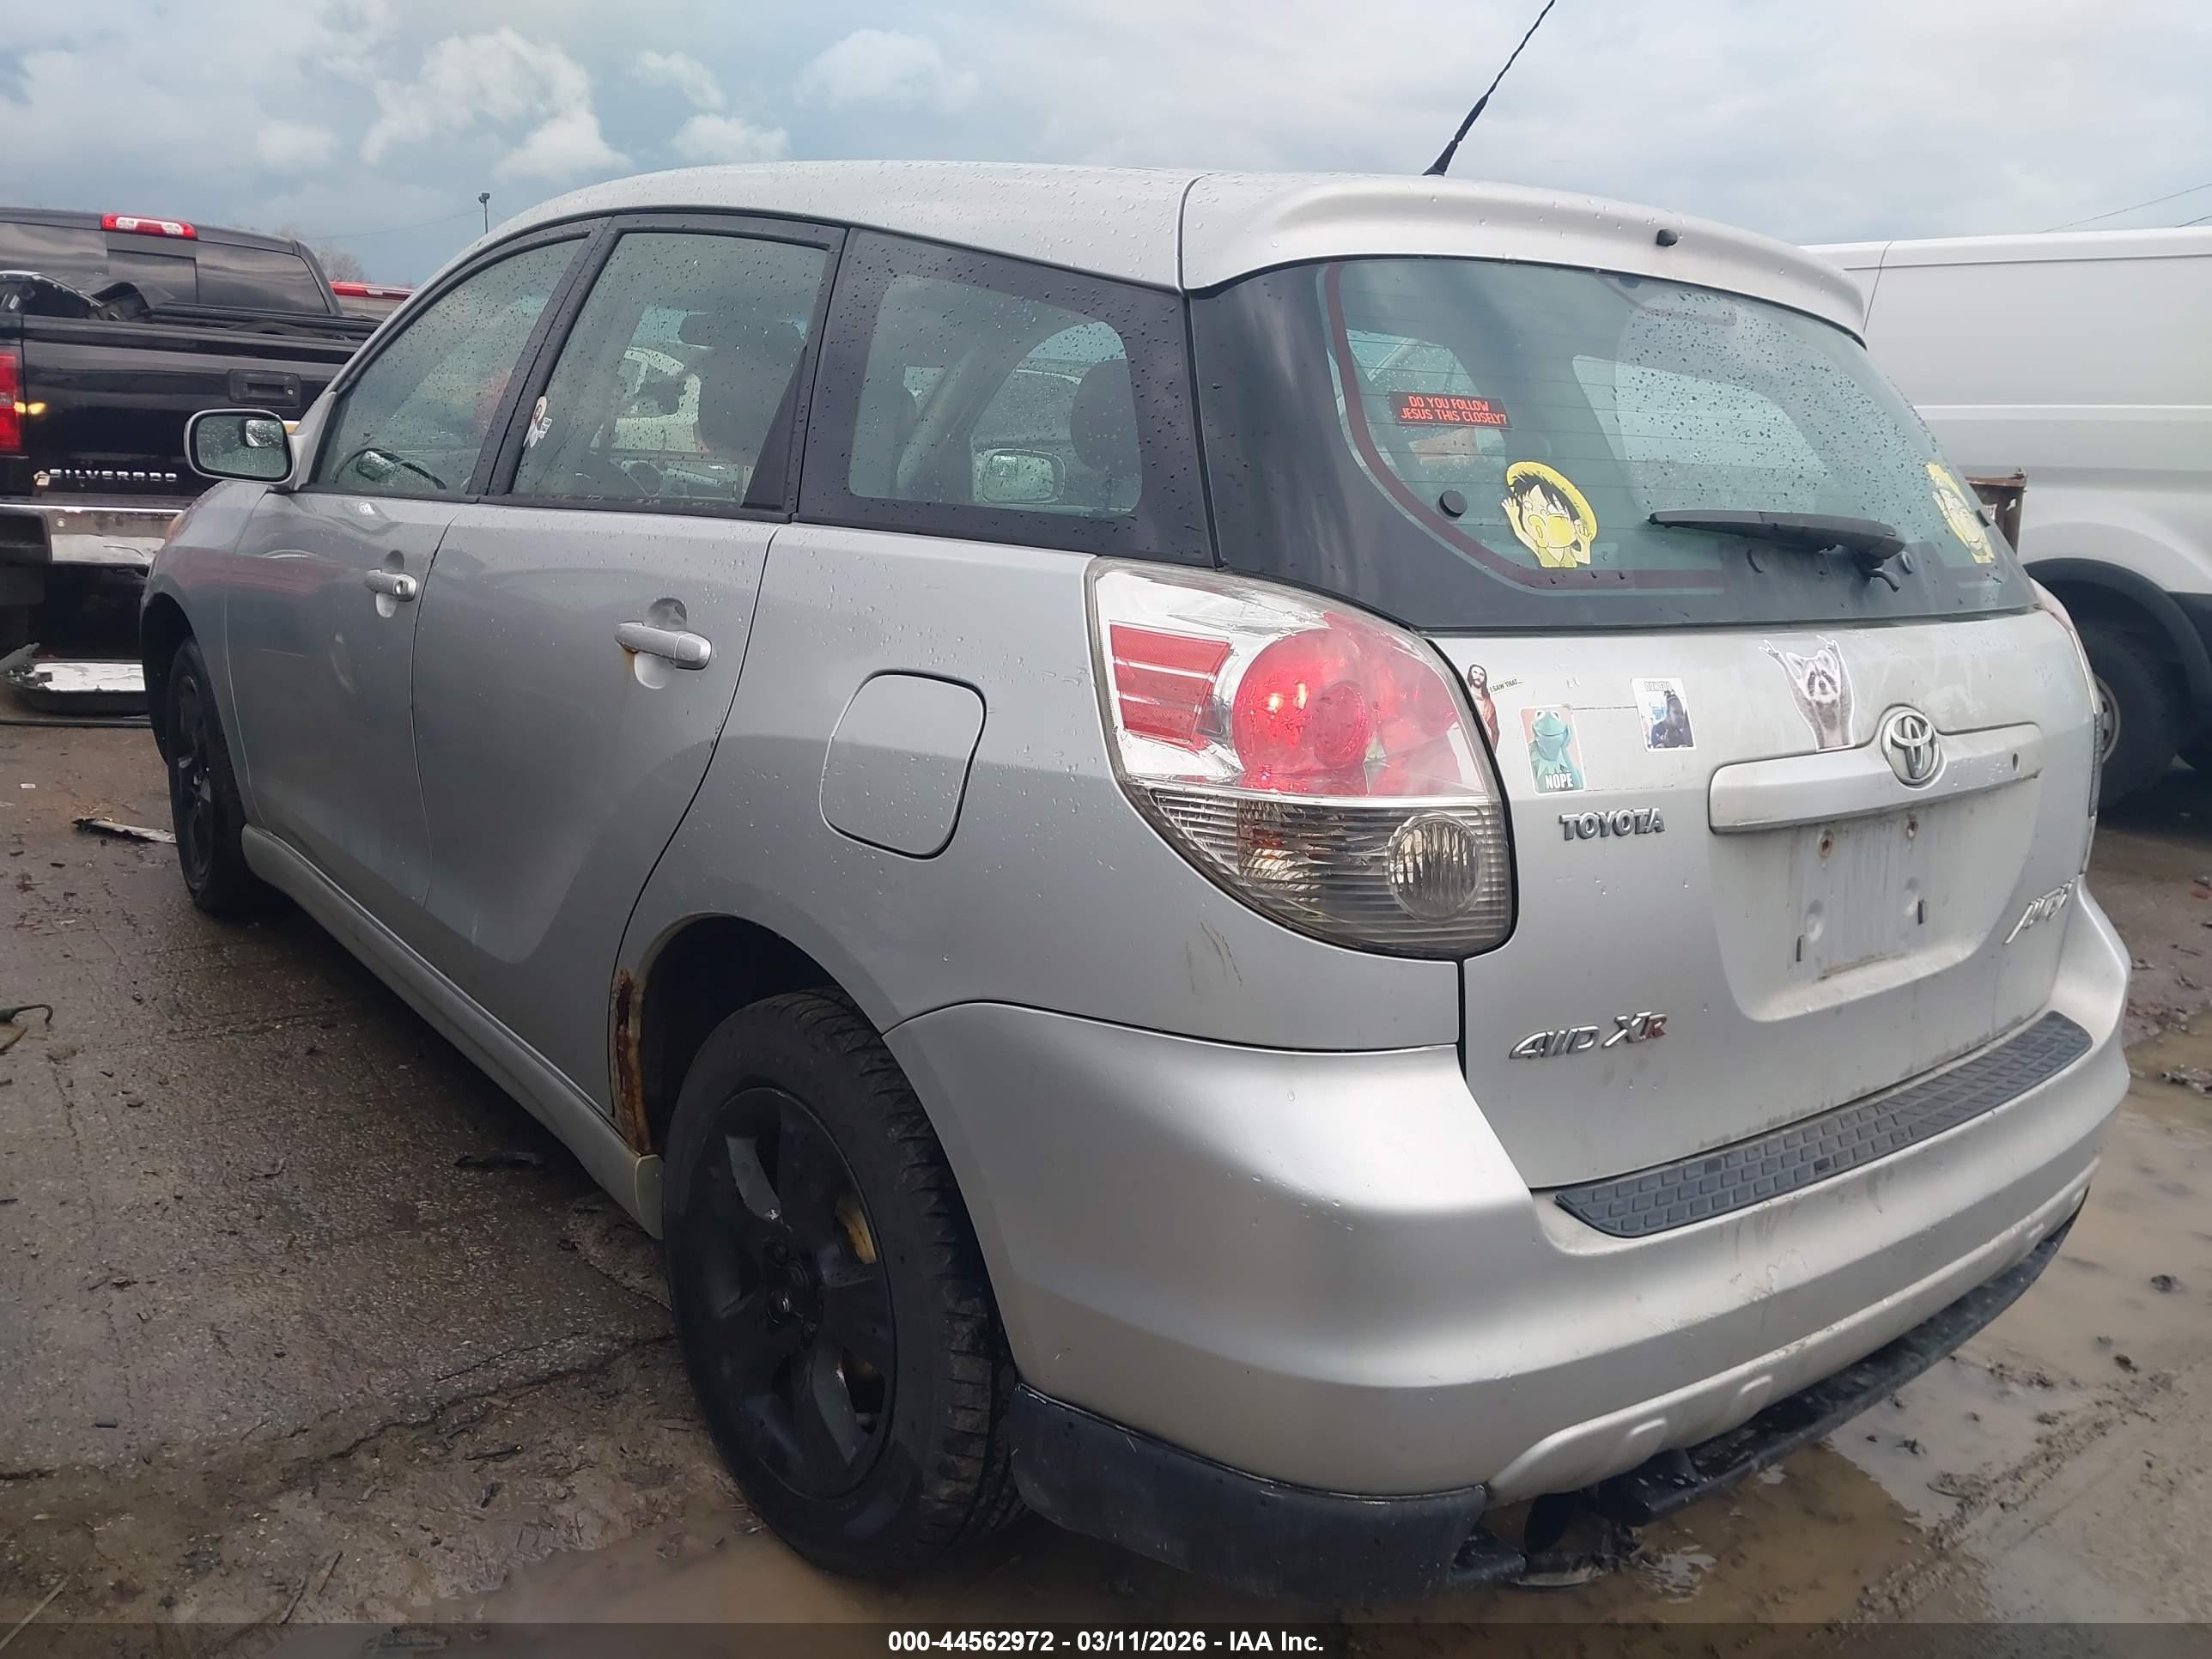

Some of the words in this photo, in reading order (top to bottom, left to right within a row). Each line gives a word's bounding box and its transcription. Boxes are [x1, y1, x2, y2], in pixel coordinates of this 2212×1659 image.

[1408, 396, 1424, 407] DO
[1426, 398, 1449, 408] YOU
[1450, 398, 1489, 411] FOLLOW
[1401, 408, 1433, 419] JESUS
[1435, 410, 1461, 421] THIS
[1462, 411, 1507, 424] CLOSELY?
[50, 469, 177, 482] SILVERADO
[1492, 683, 1504, 692] SAW
[1545, 773, 1574, 789] NOPE
[1559, 807, 1666, 841] TOYOTA
[1509, 1024, 1601, 1060] 4WD
[1601, 1011, 1668, 1048] XR
